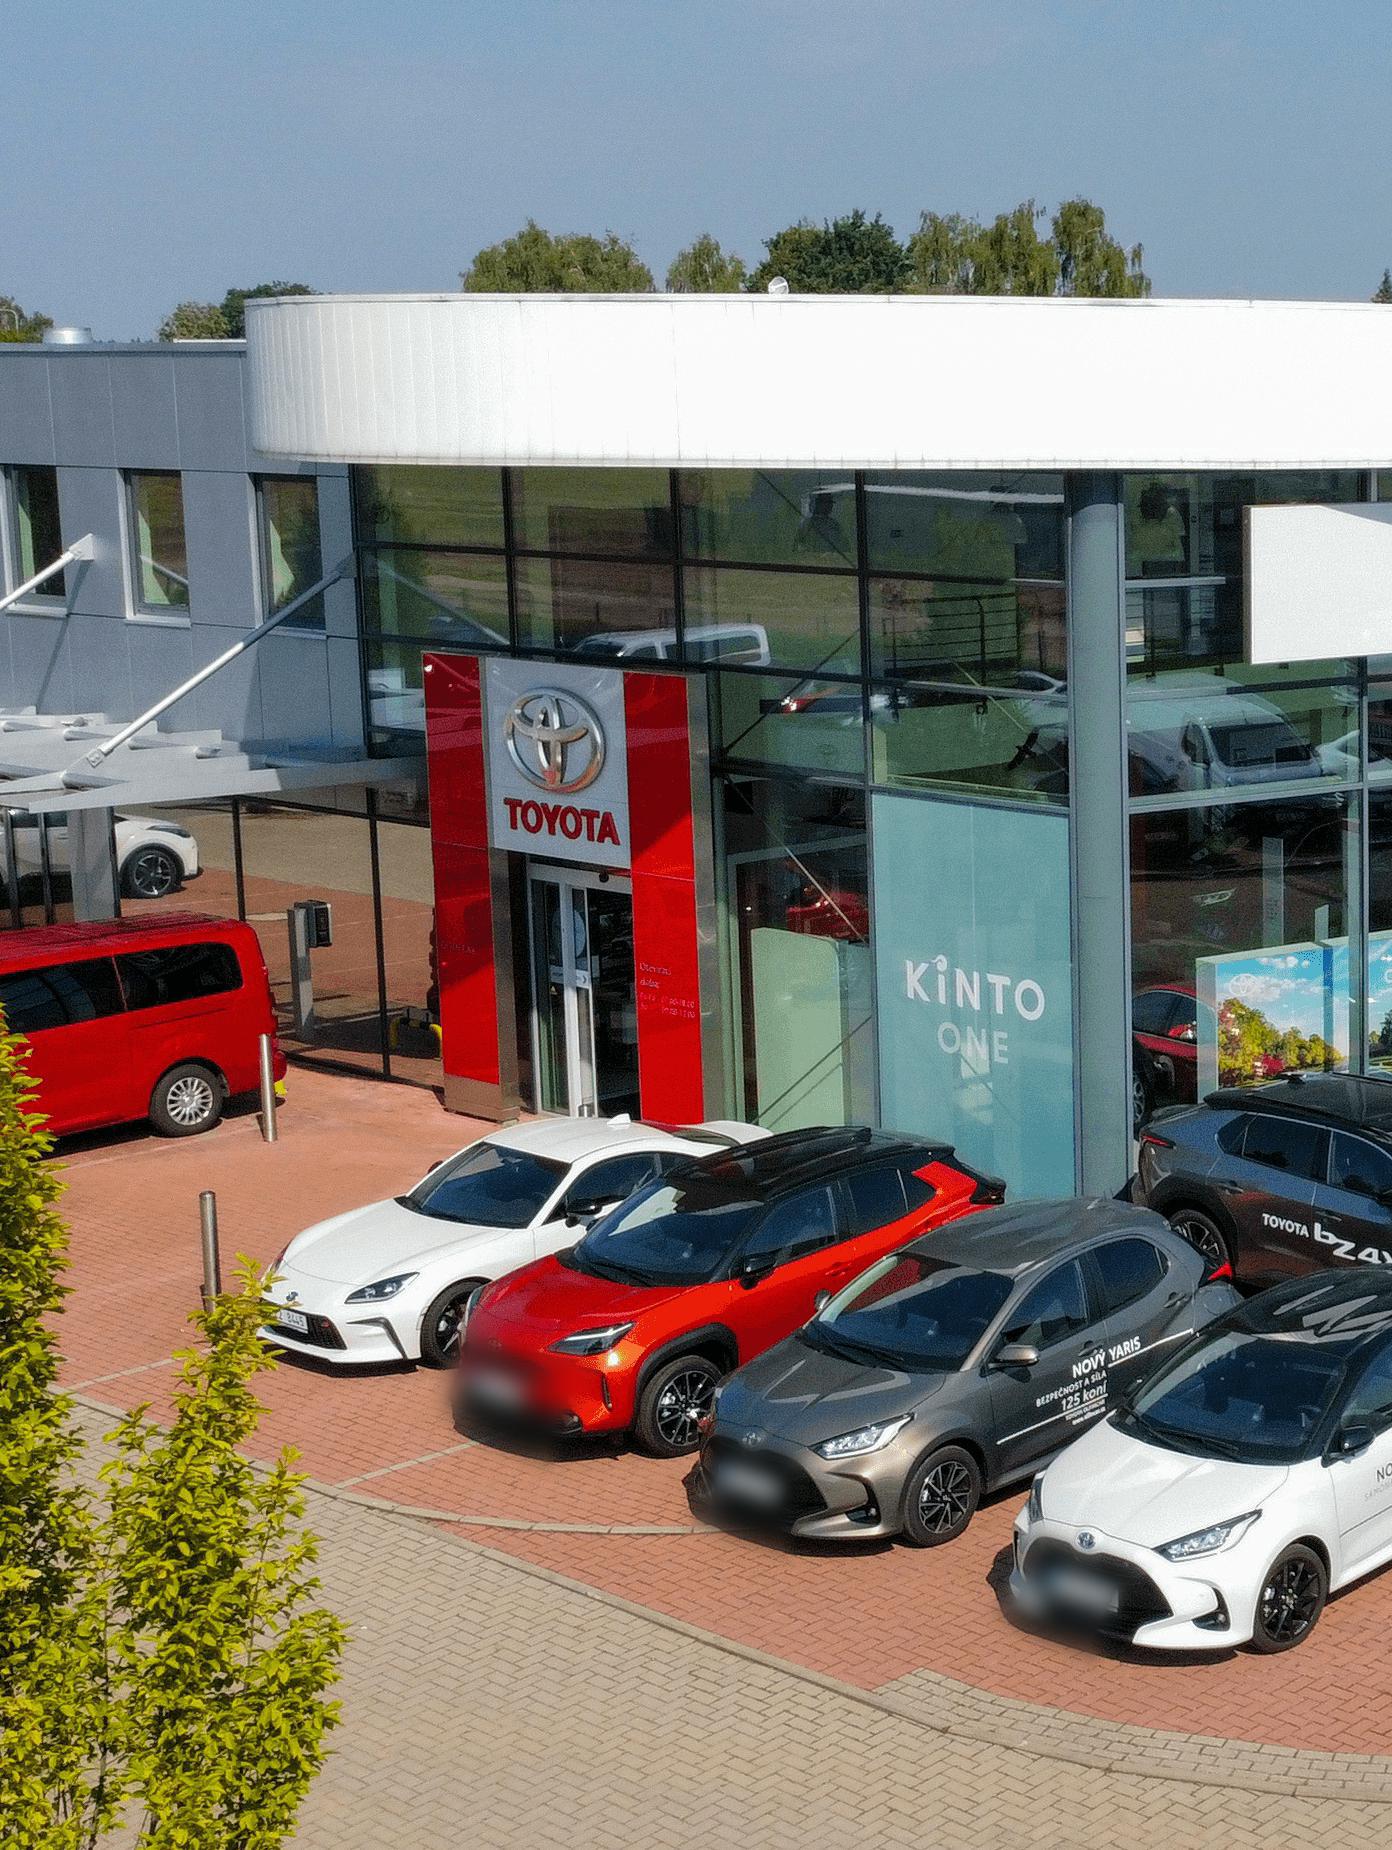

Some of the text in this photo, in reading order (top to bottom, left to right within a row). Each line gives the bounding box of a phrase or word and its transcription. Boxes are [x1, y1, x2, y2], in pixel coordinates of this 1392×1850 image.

[503, 797, 621, 846] TOYOTA
[937, 1021, 1009, 1064] ONE
[1262, 1213, 1309, 1238] TOYOTA
[1072, 1336, 1141, 1379] NOVÝ YARIS
[1036, 1370, 1107, 1408] BEZPEČNOST A SÍLA
[1061, 1392, 1081, 1411] 125
[1083, 1380, 1108, 1402] koní
